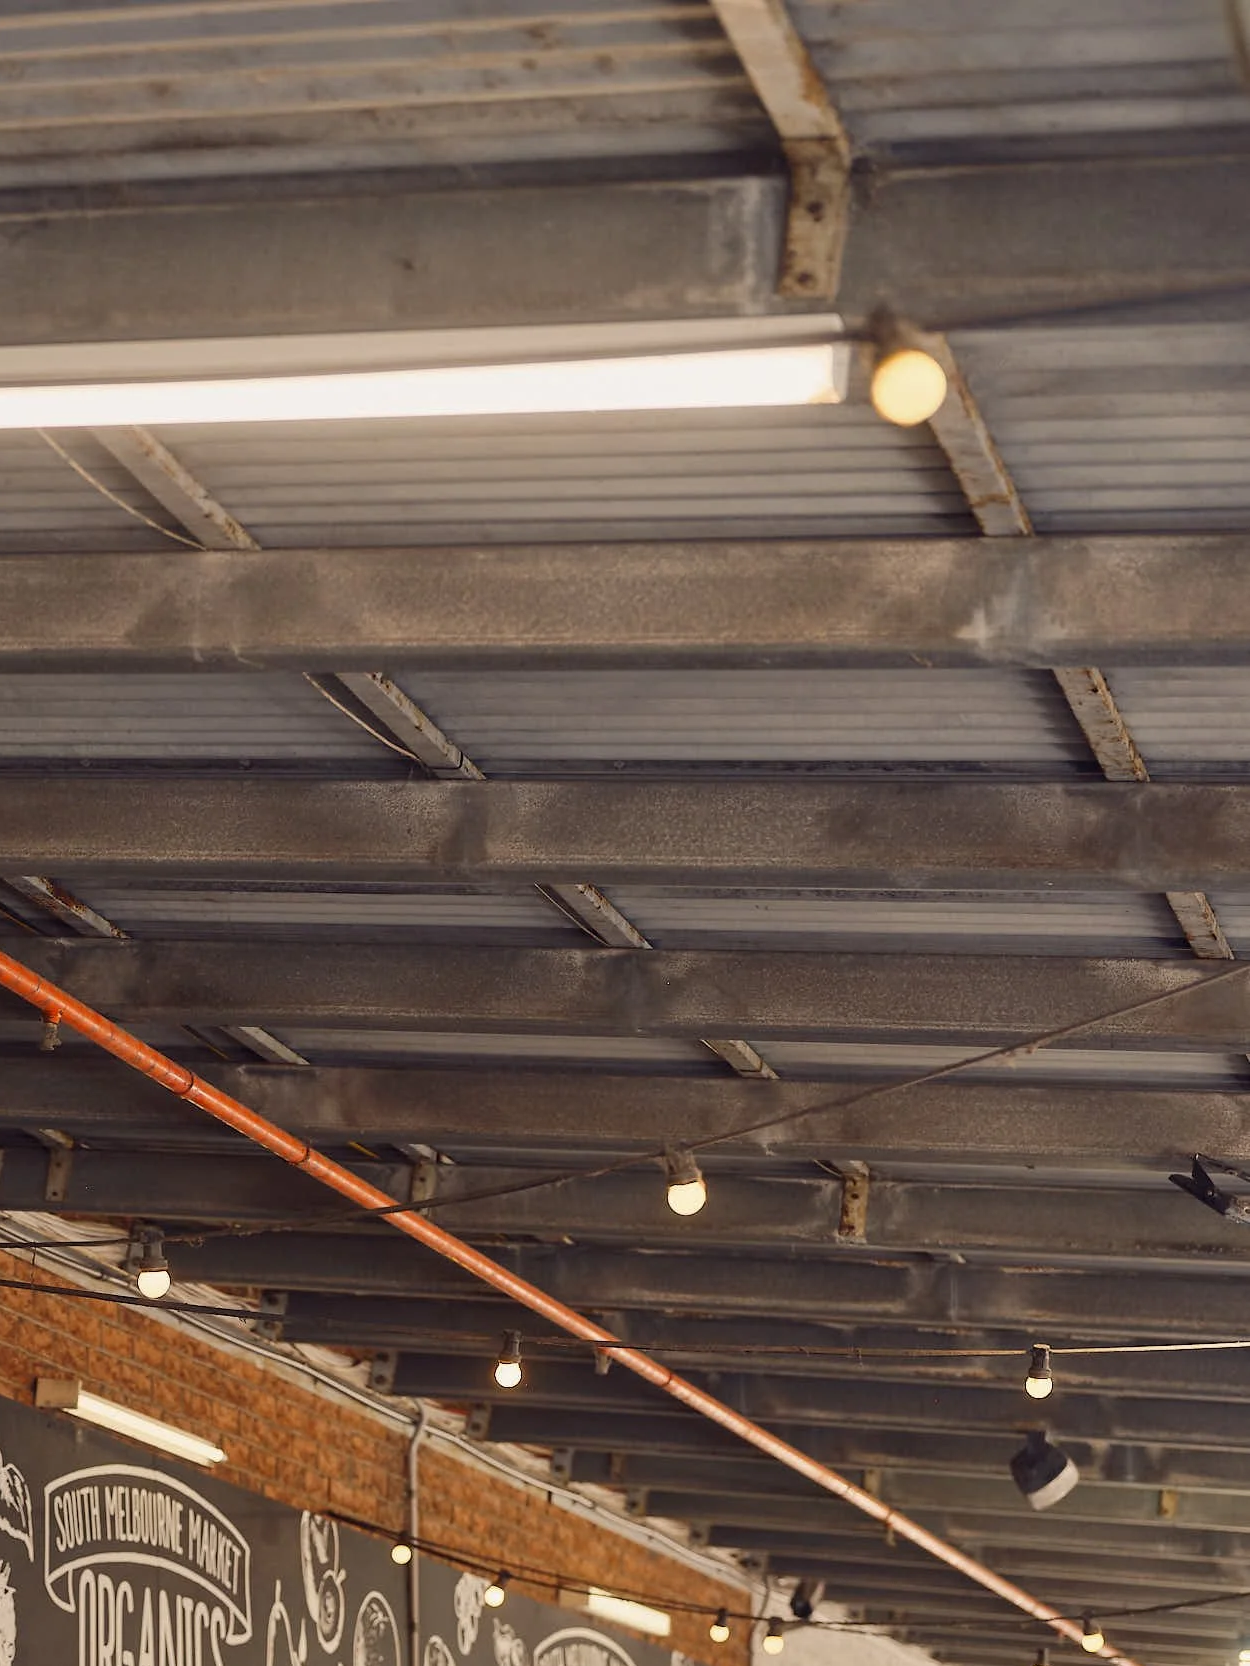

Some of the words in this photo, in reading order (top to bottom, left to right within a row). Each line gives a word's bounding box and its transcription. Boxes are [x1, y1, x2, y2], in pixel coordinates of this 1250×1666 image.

[54, 1485, 101, 1552] SOUTH
[104, 1485, 184, 1555] MELBOURNE
[188, 1508, 242, 1595] MARKET
